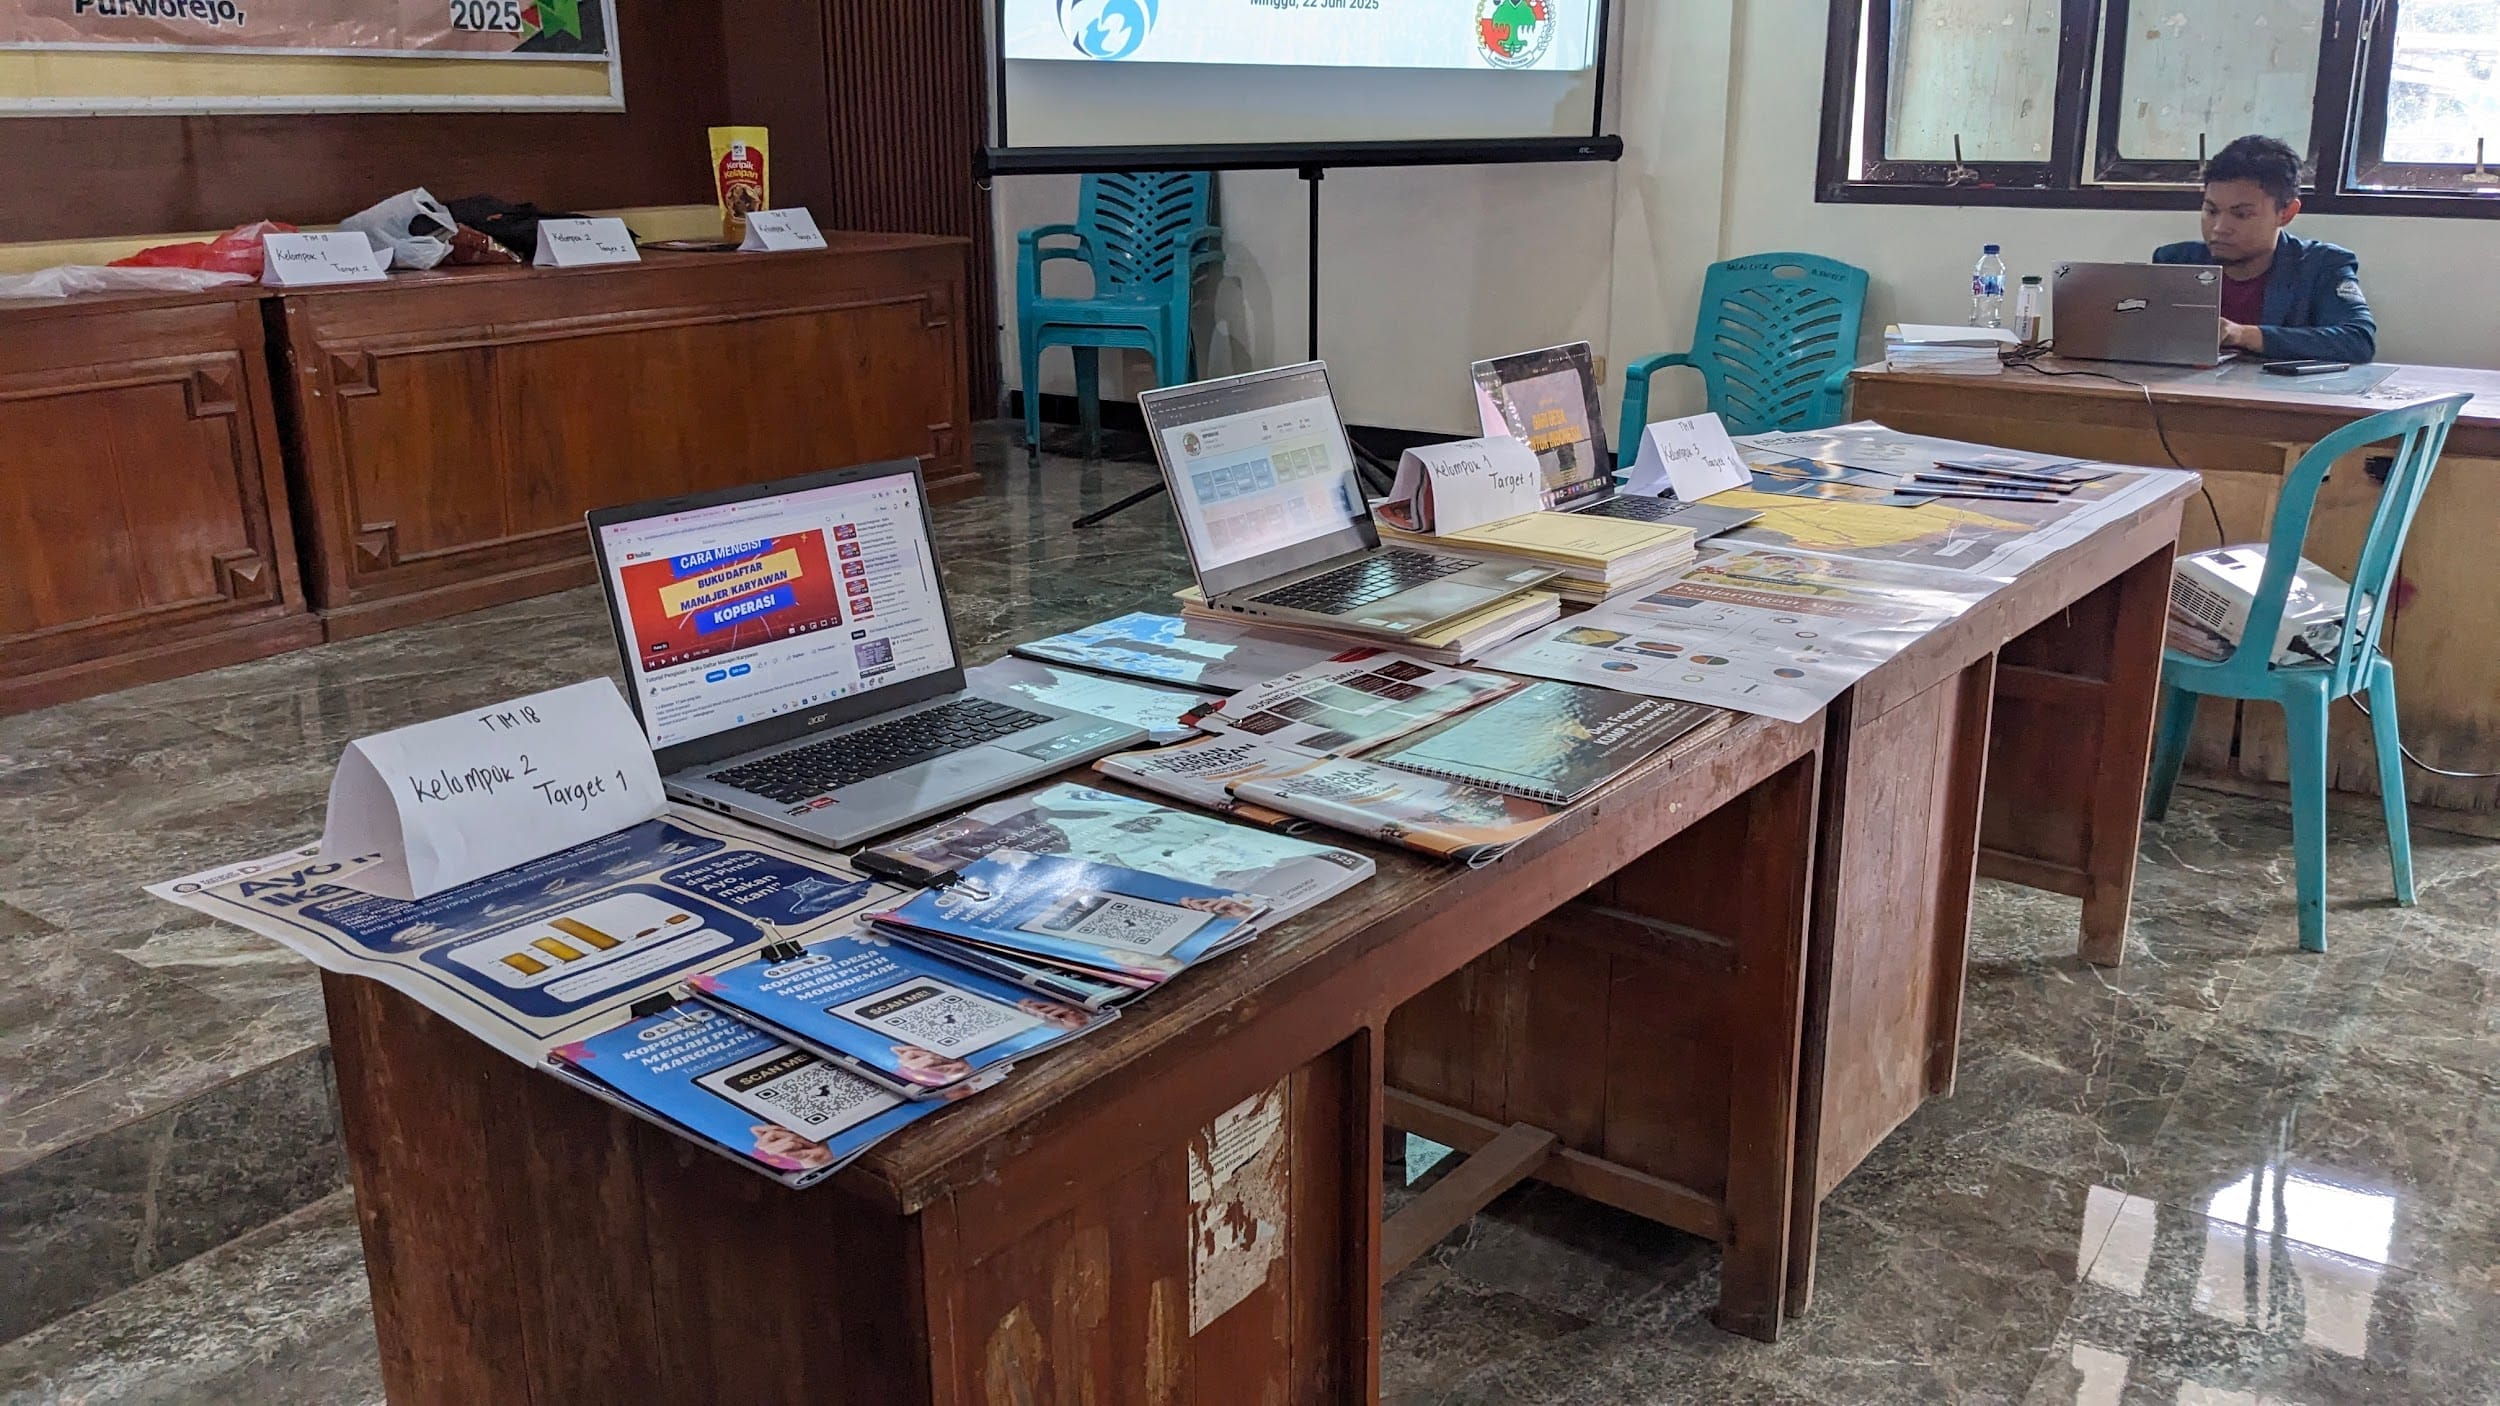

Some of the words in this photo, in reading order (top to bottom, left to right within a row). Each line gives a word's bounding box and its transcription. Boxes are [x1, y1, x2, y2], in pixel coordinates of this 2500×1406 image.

[75, 0, 245, 25] Purworejo,
[451, 0, 521, 30] 2025
[1321, 0, 1346, 9] Juni
[1350, 0, 1379, 9] 2025
[275, 247, 317, 263] Kelompok
[1692, 442, 1700, 456] 3
[1431, 458, 1481, 478] Kelompok
[1483, 454, 1493, 469] 1
[1488, 471, 1524, 494] Target
[1528, 471, 1535, 486] 1
[680, 550, 713, 569] CARA
[714, 539, 763, 560] MENGISI
[697, 571, 726, 589] BUKU
[725, 561, 764, 581] DAFTAR
[680, 588, 729, 612] MANAJER
[730, 569, 788, 596] KARYAWAN
[713, 593, 776, 624] KOPERASI
[1246, 690, 1297, 712] BUSINESS
[478, 713, 520, 732] TIM
[520, 706, 541, 724] 18
[808, 713, 828, 726] acer
[409, 765, 515, 803] Kelompok
[520, 754, 538, 776] 2
[532, 776, 606, 811] Target
[615, 769, 628, 792] 1
[969, 820, 1049, 854] Percetaka
[685, 873, 715, 887] dan
[714, 857, 768, 876] Pintar?
[710, 852, 757, 868] Sehat
[239, 862, 343, 898] Ayo
[701, 876, 745, 892] Ayo,
[717, 874, 779, 898] makan
[258, 882, 347, 907] Ika
[758, 960, 839, 992] KOPERASI
[837, 950, 880, 968] DESA
[776, 972, 839, 997] MERAH
[837, 956, 890, 979] PUTIH
[795, 962, 900, 1001] MORODEMAK
[868, 1000, 907, 1017] SCAN
[622, 1019, 711, 1061] KOPERASI
[641, 1033, 711, 1066] MERAH
[738, 1064, 783, 1086] SCAN
